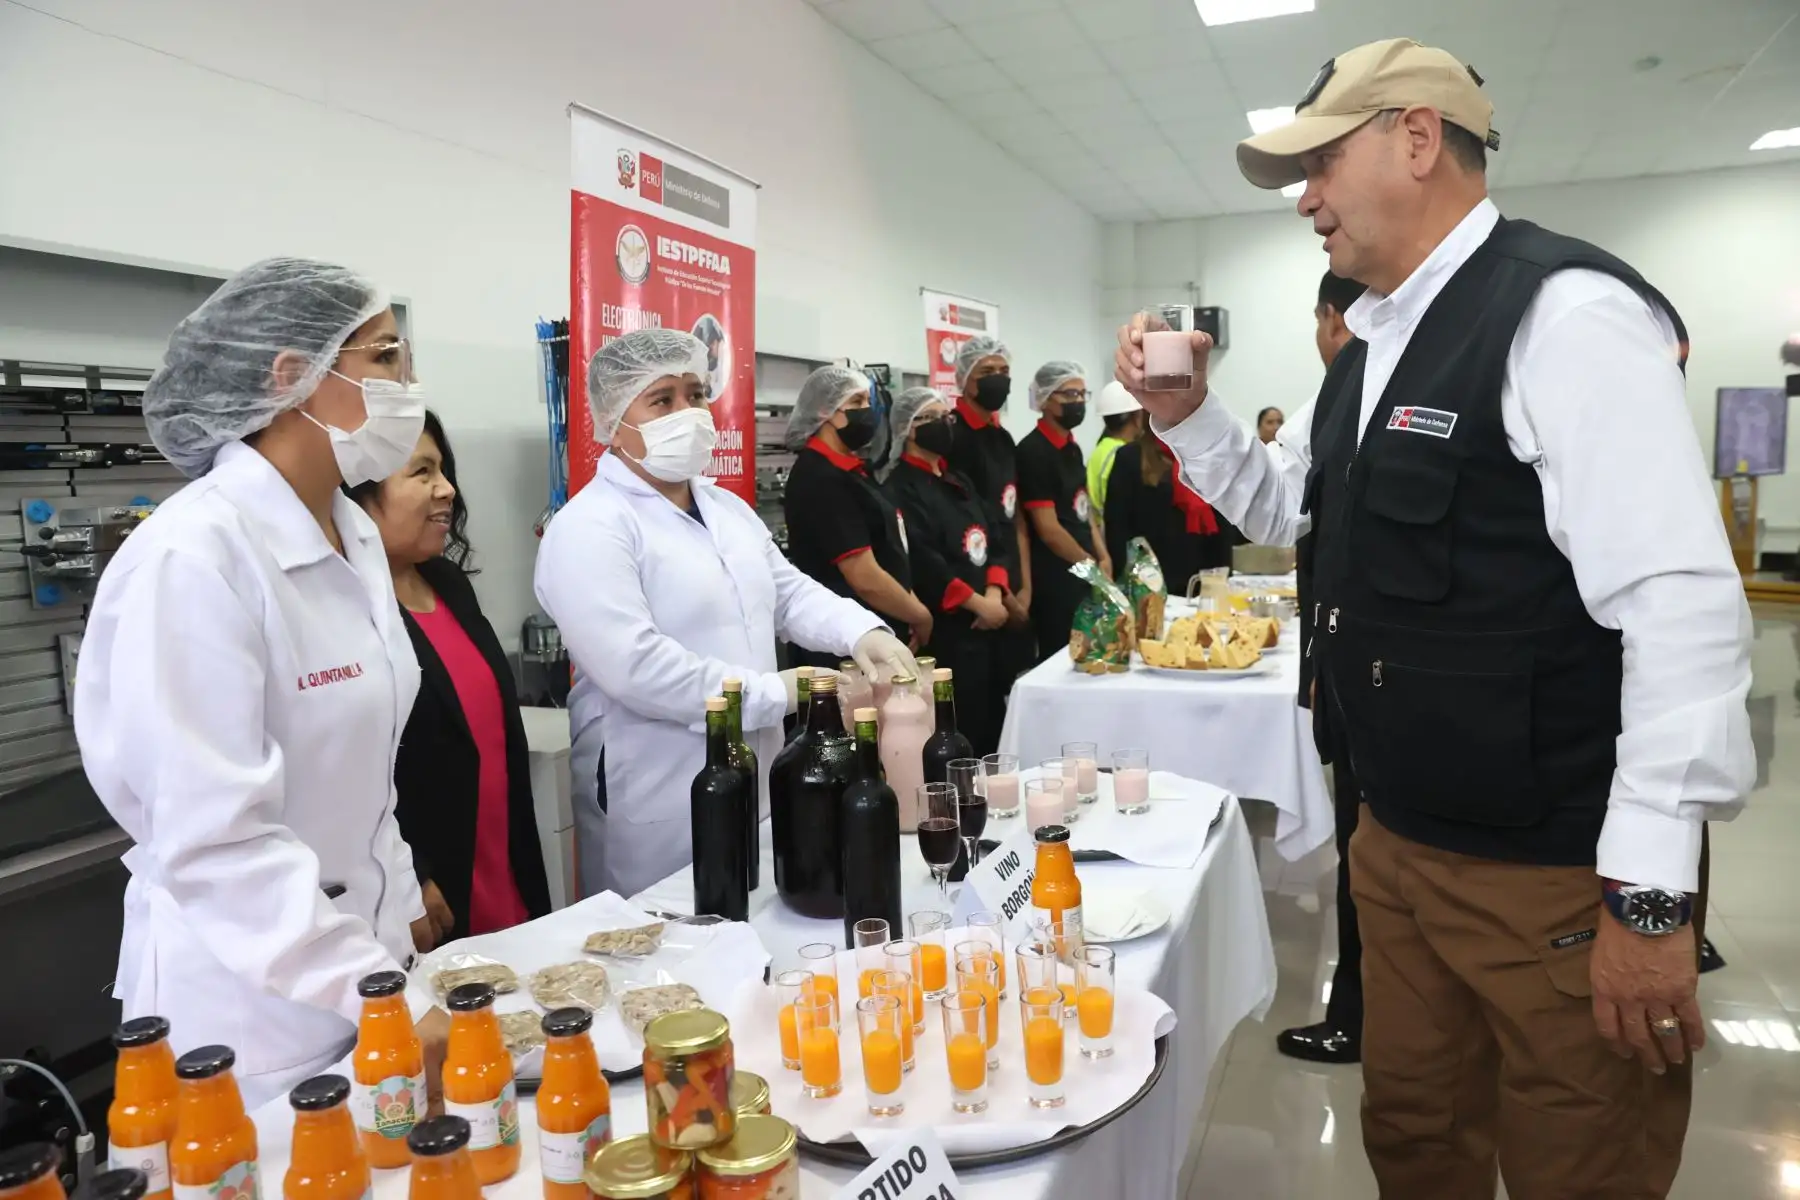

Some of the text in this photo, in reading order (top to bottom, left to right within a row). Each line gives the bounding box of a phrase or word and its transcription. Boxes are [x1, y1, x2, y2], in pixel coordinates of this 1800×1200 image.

[642, 169, 660, 188] PERÚ
[656, 235, 732, 276] IESTPFFAA
[602, 303, 663, 331] ELECTRÓNICA
[714, 427, 742, 450] ACIÓN
[307, 662, 364, 688] QUINTANILLA
[994, 850, 1020, 882] VINO
